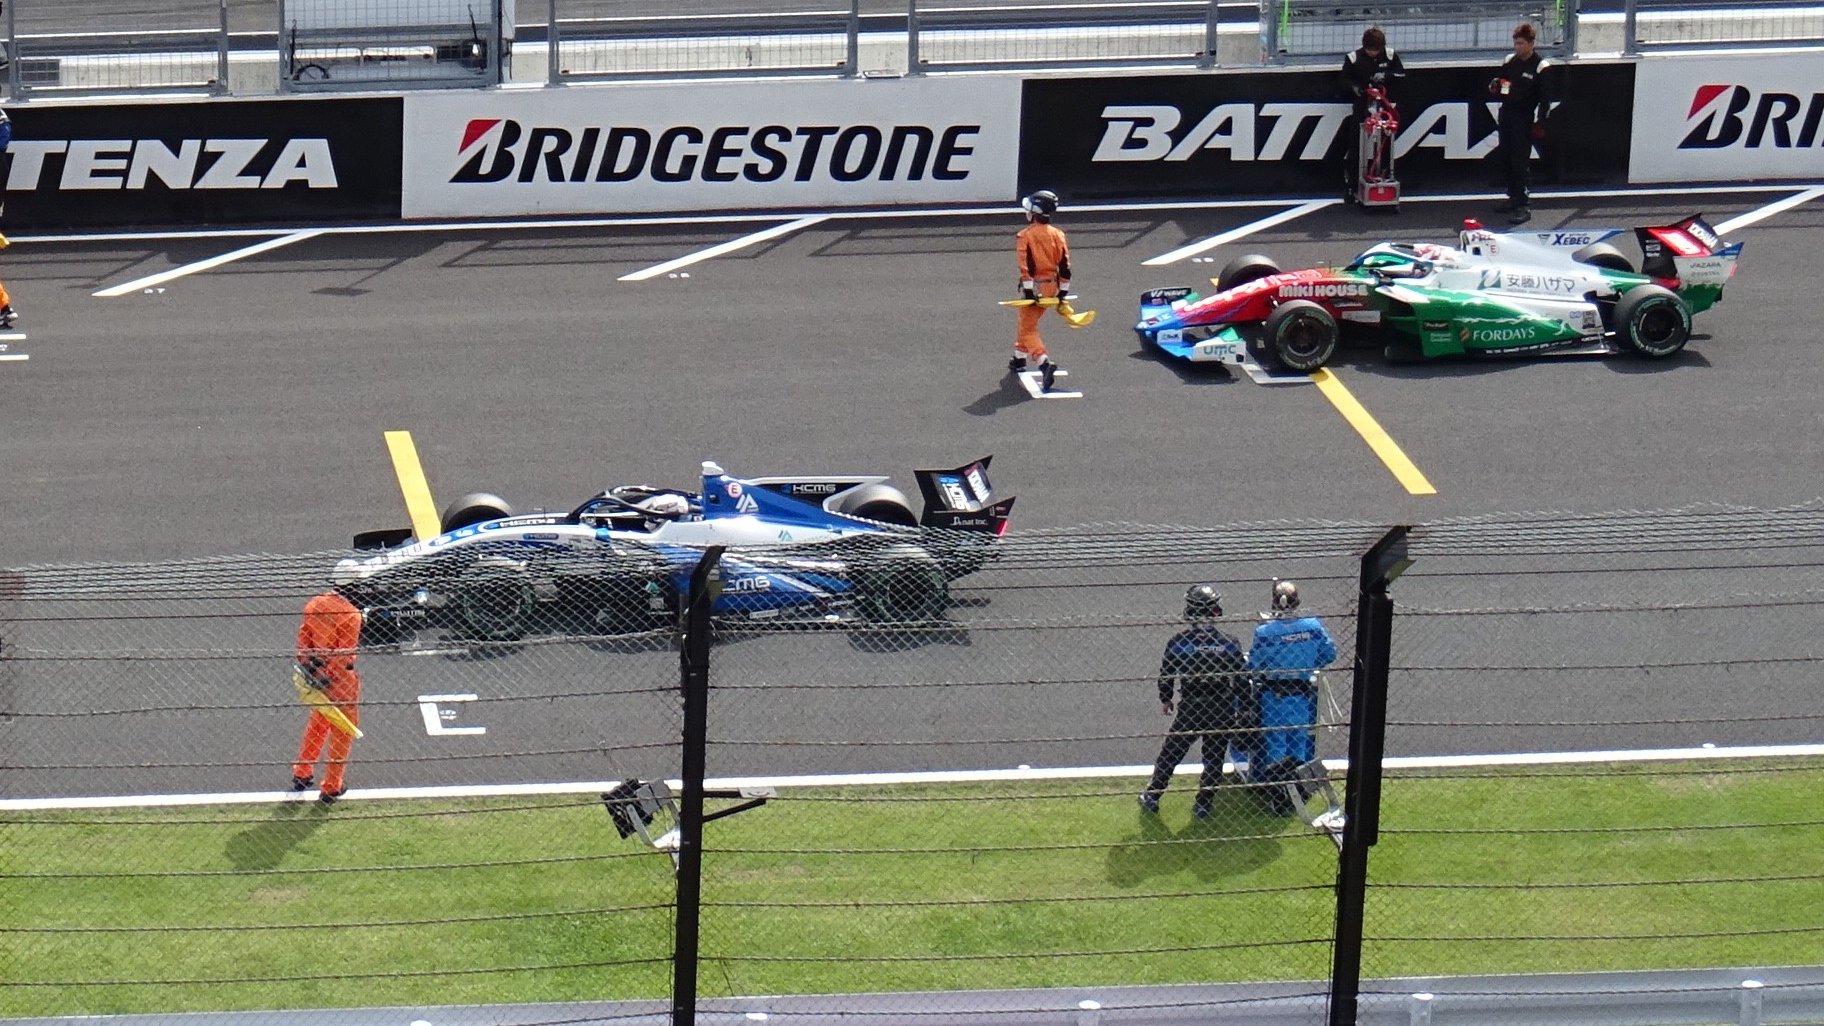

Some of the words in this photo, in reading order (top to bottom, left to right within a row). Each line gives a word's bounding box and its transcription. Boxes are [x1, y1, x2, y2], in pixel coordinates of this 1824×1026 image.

[449, 119, 980, 184] BRIDGESTONE
[1552, 234, 1591, 246] XEBEC
[1507, 274, 1575, 292] 安藤ハザマ
[1318, 284, 1368, 297] HOUSE
[1473, 327, 1536, 341] FORDAYS
[722, 576, 771, 591] CMG
